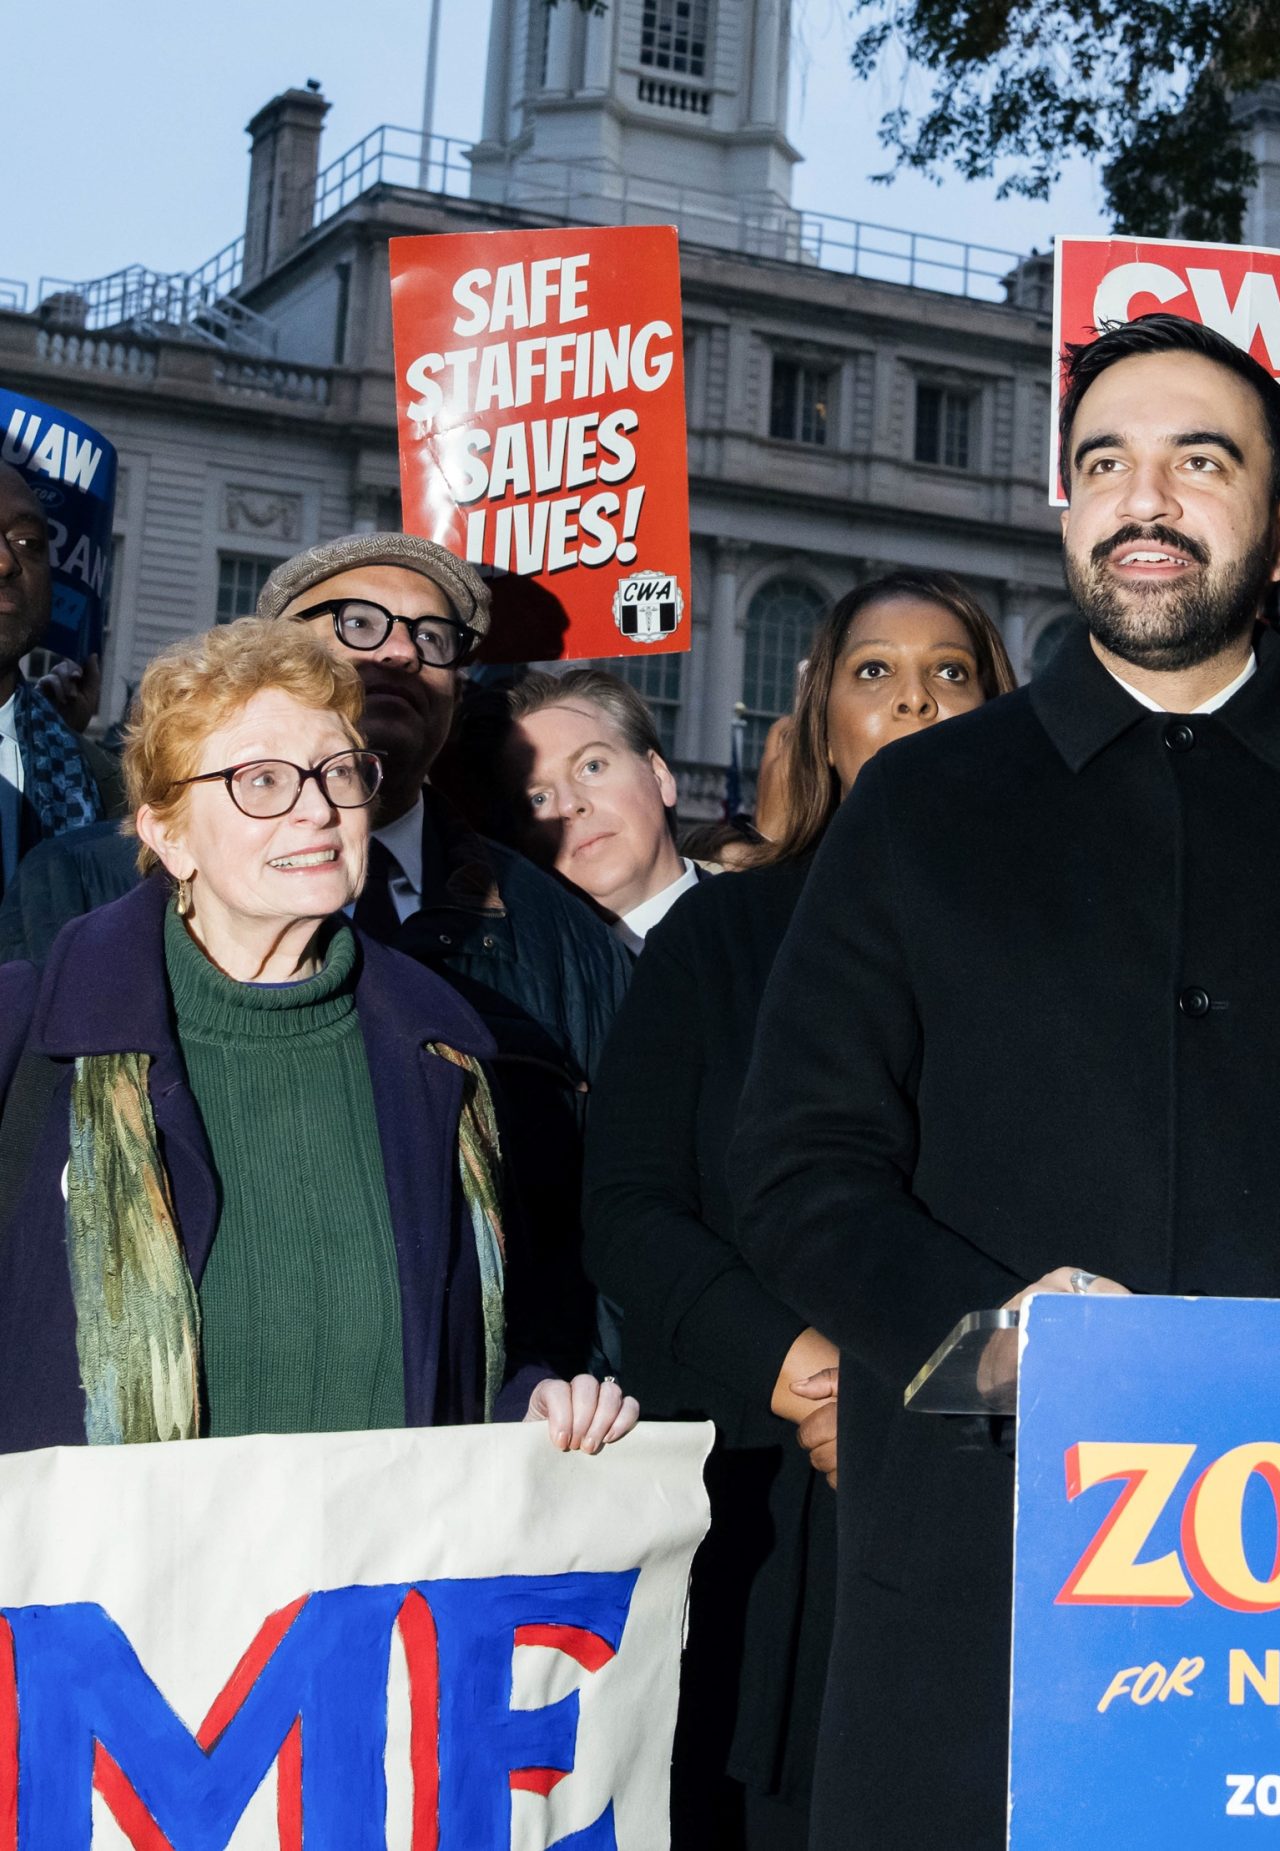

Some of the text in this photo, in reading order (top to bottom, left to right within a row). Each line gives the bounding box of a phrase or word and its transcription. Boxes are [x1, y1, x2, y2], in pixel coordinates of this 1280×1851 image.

[453, 253, 590, 337] SAFE
[406, 320, 674, 423] STAFFING
[1, 408, 103, 494] UAW
[452, 408, 639, 505] SAVES
[48, 518, 108, 598] RAN
[465, 485, 646, 578] LIVES!
[624, 580, 671, 602] CWA
[1097, 1656, 1205, 1713] FOR
